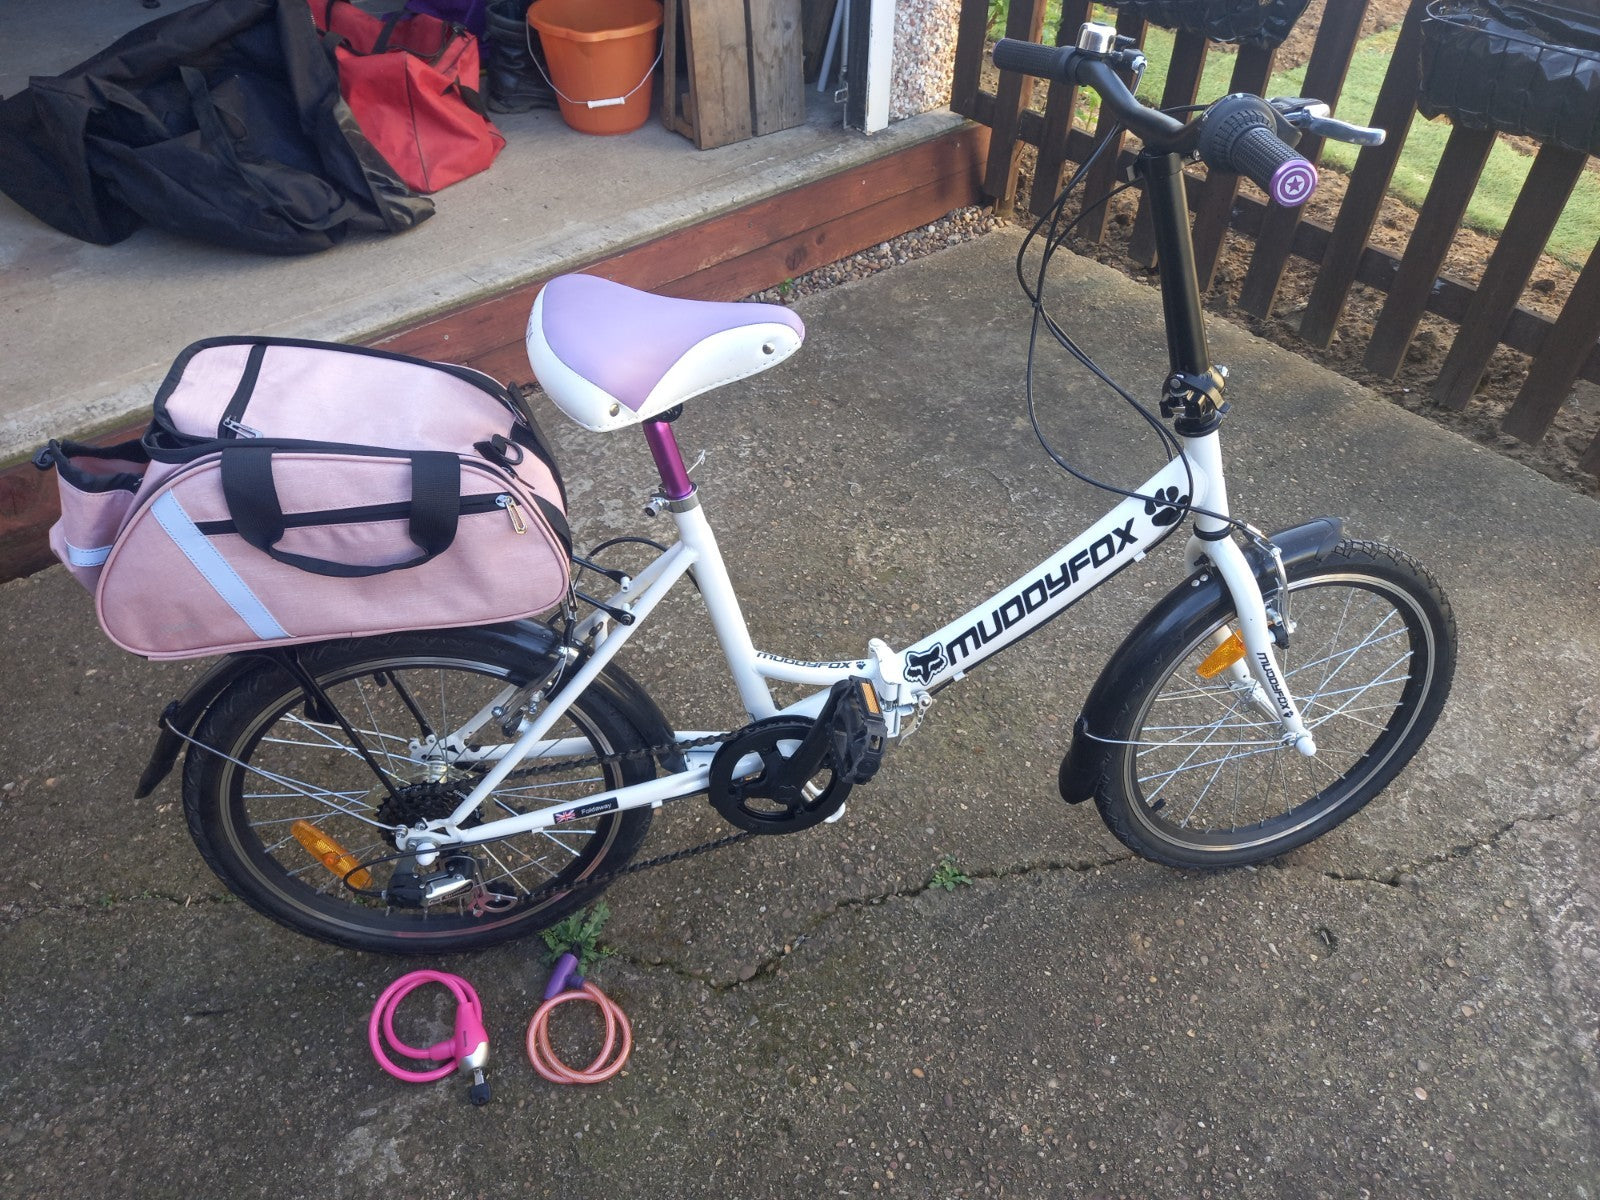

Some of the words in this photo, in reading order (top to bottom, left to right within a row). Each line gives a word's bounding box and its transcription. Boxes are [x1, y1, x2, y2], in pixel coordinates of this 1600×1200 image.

[946, 517, 1138, 666] MUDDYFOX
[756, 652, 851, 669] MUDDYFOX
[1256, 652, 1290, 710] MUDDYFOX
[581, 803, 612, 815] Foldaway
